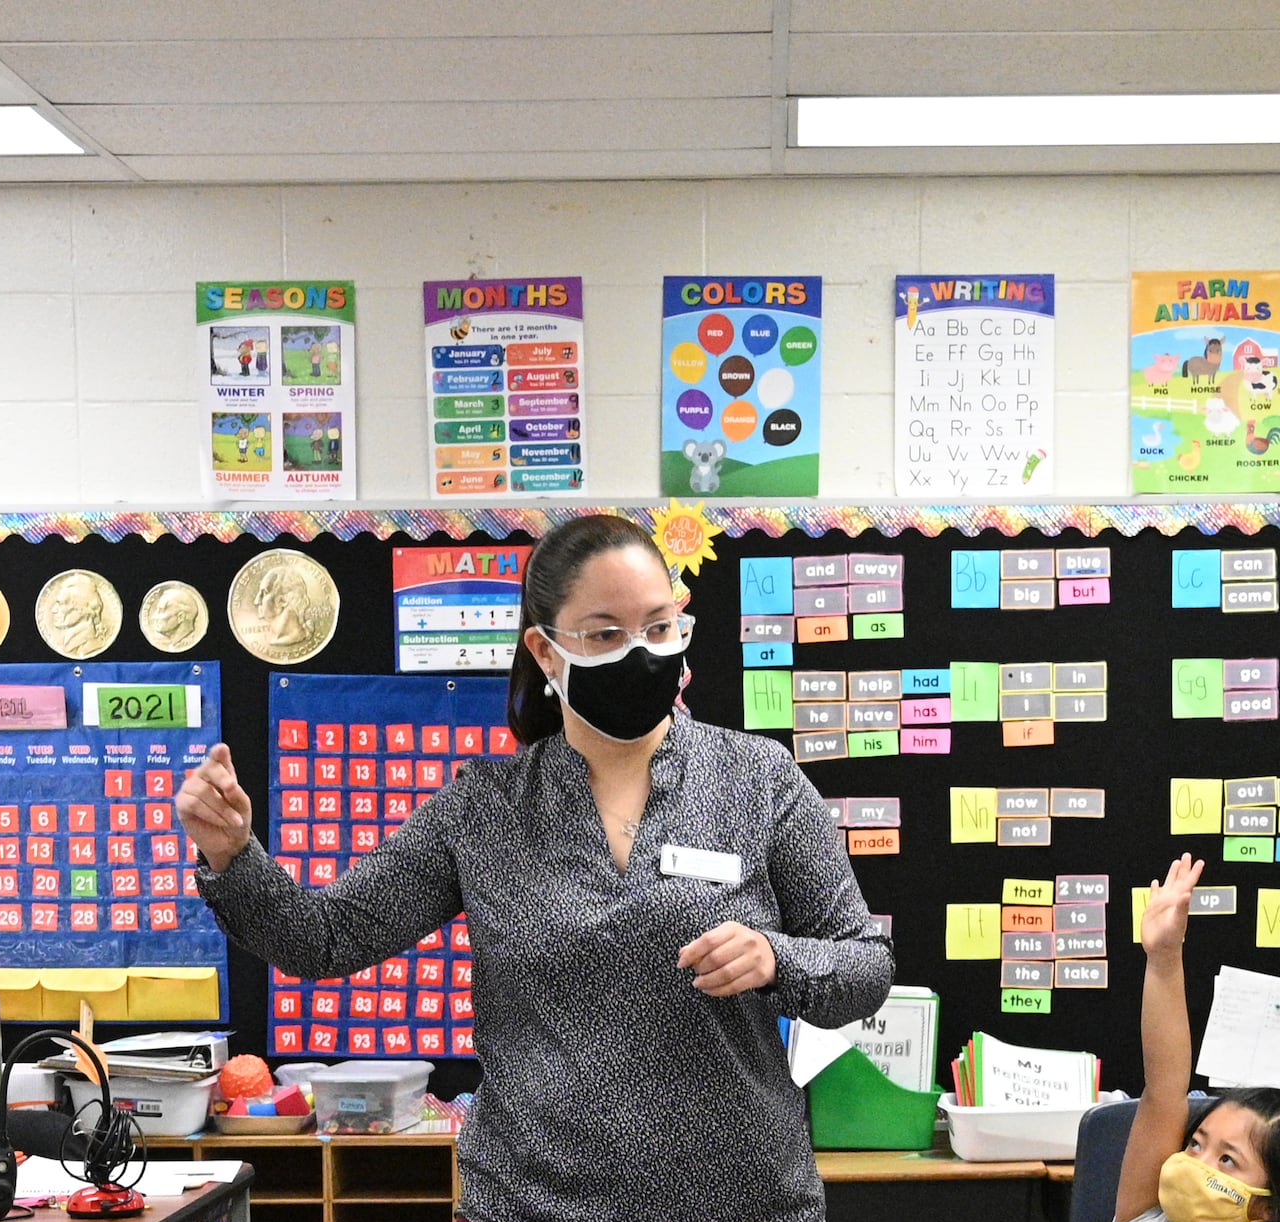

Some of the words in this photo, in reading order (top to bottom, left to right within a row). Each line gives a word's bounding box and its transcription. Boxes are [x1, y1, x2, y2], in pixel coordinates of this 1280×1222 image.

[681, 281, 808, 305] COLORS
[930, 279, 1046, 302] WRITING
[1176, 278, 1250, 300] FARM
[205, 286, 346, 311] SEASONS
[436, 283, 569, 310] MONTHS
[1154, 301, 1272, 323] ANIMALS
[707, 329, 724, 337] RED
[750, 329, 771, 338] BLUE
[913, 319, 936, 337] Aa
[946, 318, 969, 337] Bb
[980, 318, 1003, 337] Cc
[1012, 318, 1036, 337] Dd
[448, 349, 487, 359] January
[532, 347, 552, 357] July
[526, 372, 560, 382] August
[722, 372, 751, 380] BROWN
[217, 388, 265, 397] WINTER
[289, 387, 335, 398] SPRING
[1154, 387, 1169, 395] PIG
[1190, 386, 1221, 394] HORSE
[1250, 403, 1272, 411] COW
[525, 422, 564, 432] October
[770, 423, 797, 431] BLACK
[1206, 439, 1236, 447] SHEEP
[521, 447, 570, 457] November
[1140, 447, 1164, 455] DUCK
[1236, 459, 1280, 468] ROOSTER
[215, 472, 270, 483] SUMMER
[287, 473, 340, 483] AUTUMN
[522, 472, 570, 482] December
[1169, 473, 1209, 483] CHICKEN
[426, 551, 519, 577] MATH
[1017, 557, 1039, 571] be
[1066, 555, 1102, 569] blue
[1233, 558, 1264, 571] can
[805, 563, 835, 577] and
[854, 563, 898, 578] away
[955, 553, 987, 592] Bb
[866, 590, 887, 604] all
[1013, 587, 1040, 604] big
[1072, 586, 1096, 598] but
[1227, 590, 1272, 604] come
[402, 597, 443, 606] Addition
[754, 624, 782, 636] are
[402, 634, 459, 644] Subtraction
[912, 674, 939, 688] had
[1240, 668, 1261, 682] go
[800, 679, 837, 692] here
[858, 678, 893, 694] help
[108, 691, 175, 722] 2021
[912, 704, 938, 718] has
[1230, 696, 1272, 714] good
[854, 708, 894, 722] have
[804, 737, 837, 751] how
[863, 737, 883, 751] his
[912, 734, 938, 748] him
[26, 755, 57, 766] Tuesday
[61, 755, 100, 766] Wednesday
[103, 754, 137, 766] Thursday
[146, 754, 172, 766] Friday
[1237, 784, 1264, 798] out
[1005, 797, 1038, 809] now
[1068, 797, 1088, 809] no
[861, 805, 885, 820] my
[1011, 824, 1037, 838] not
[356, 831, 376, 847] 33
[853, 835, 894, 849] made
[1240, 845, 1258, 856] on
[313, 864, 333, 880] 42
[35, 875, 57, 891] 20
[74, 875, 95, 892] 21
[1058, 883, 1070, 896] 2
[1075, 881, 1105, 895] two
[1013, 884, 1043, 899] that
[1199, 894, 1220, 909] up
[153, 908, 175, 924] 30
[1011, 913, 1043, 926] than
[1013, 938, 1043, 952] this
[1055, 937, 1066, 951] 3
[1067, 936, 1104, 949] three
[1014, 967, 1041, 981] the
[1063, 966, 1100, 980] take
[382, 997, 403, 1013] 84
[1010, 994, 1043, 1010] they
[861, 1015, 887, 1035] My
[421, 1033, 440, 1049] 95
[1017, 1059, 1042, 1074] My
